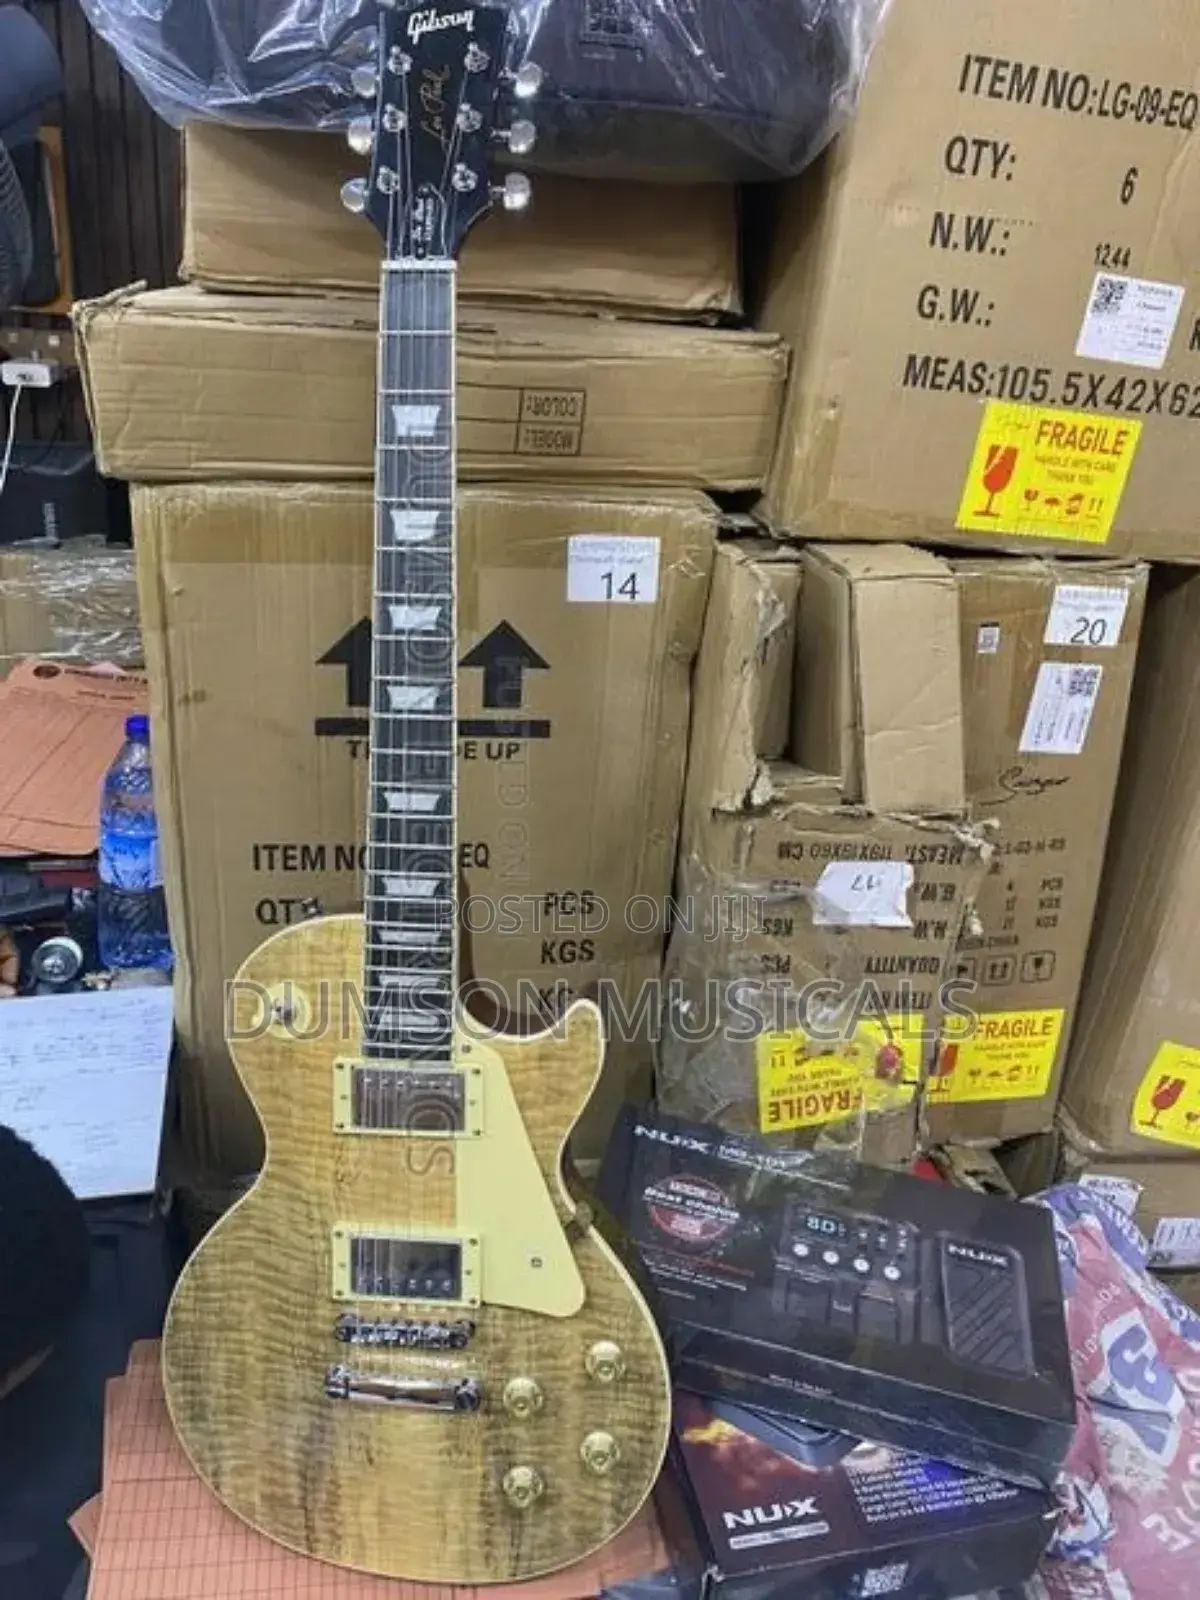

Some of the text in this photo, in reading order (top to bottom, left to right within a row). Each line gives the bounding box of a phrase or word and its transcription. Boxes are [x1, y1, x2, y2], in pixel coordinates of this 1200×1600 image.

[407, 9, 475, 44] Gibson
[958, 53, 1039, 104] ITEM
[943, 135, 1138, 205] QTY: 6
[929, 211, 1010, 256] N.W.:
[917, 285, 995, 327] G.W.:
[1035, 419, 1130, 455] FRAGILE
[600, 571, 640, 600] 14
[1070, 616, 1108, 645] 20
[485, 740, 521, 761] UP
[252, 843, 326, 872] ITEM
[540, 938, 596, 965] KGS
[974, 1015, 1055, 1041] FRAGILE
[768, 1087, 863, 1123] FRAGILE
